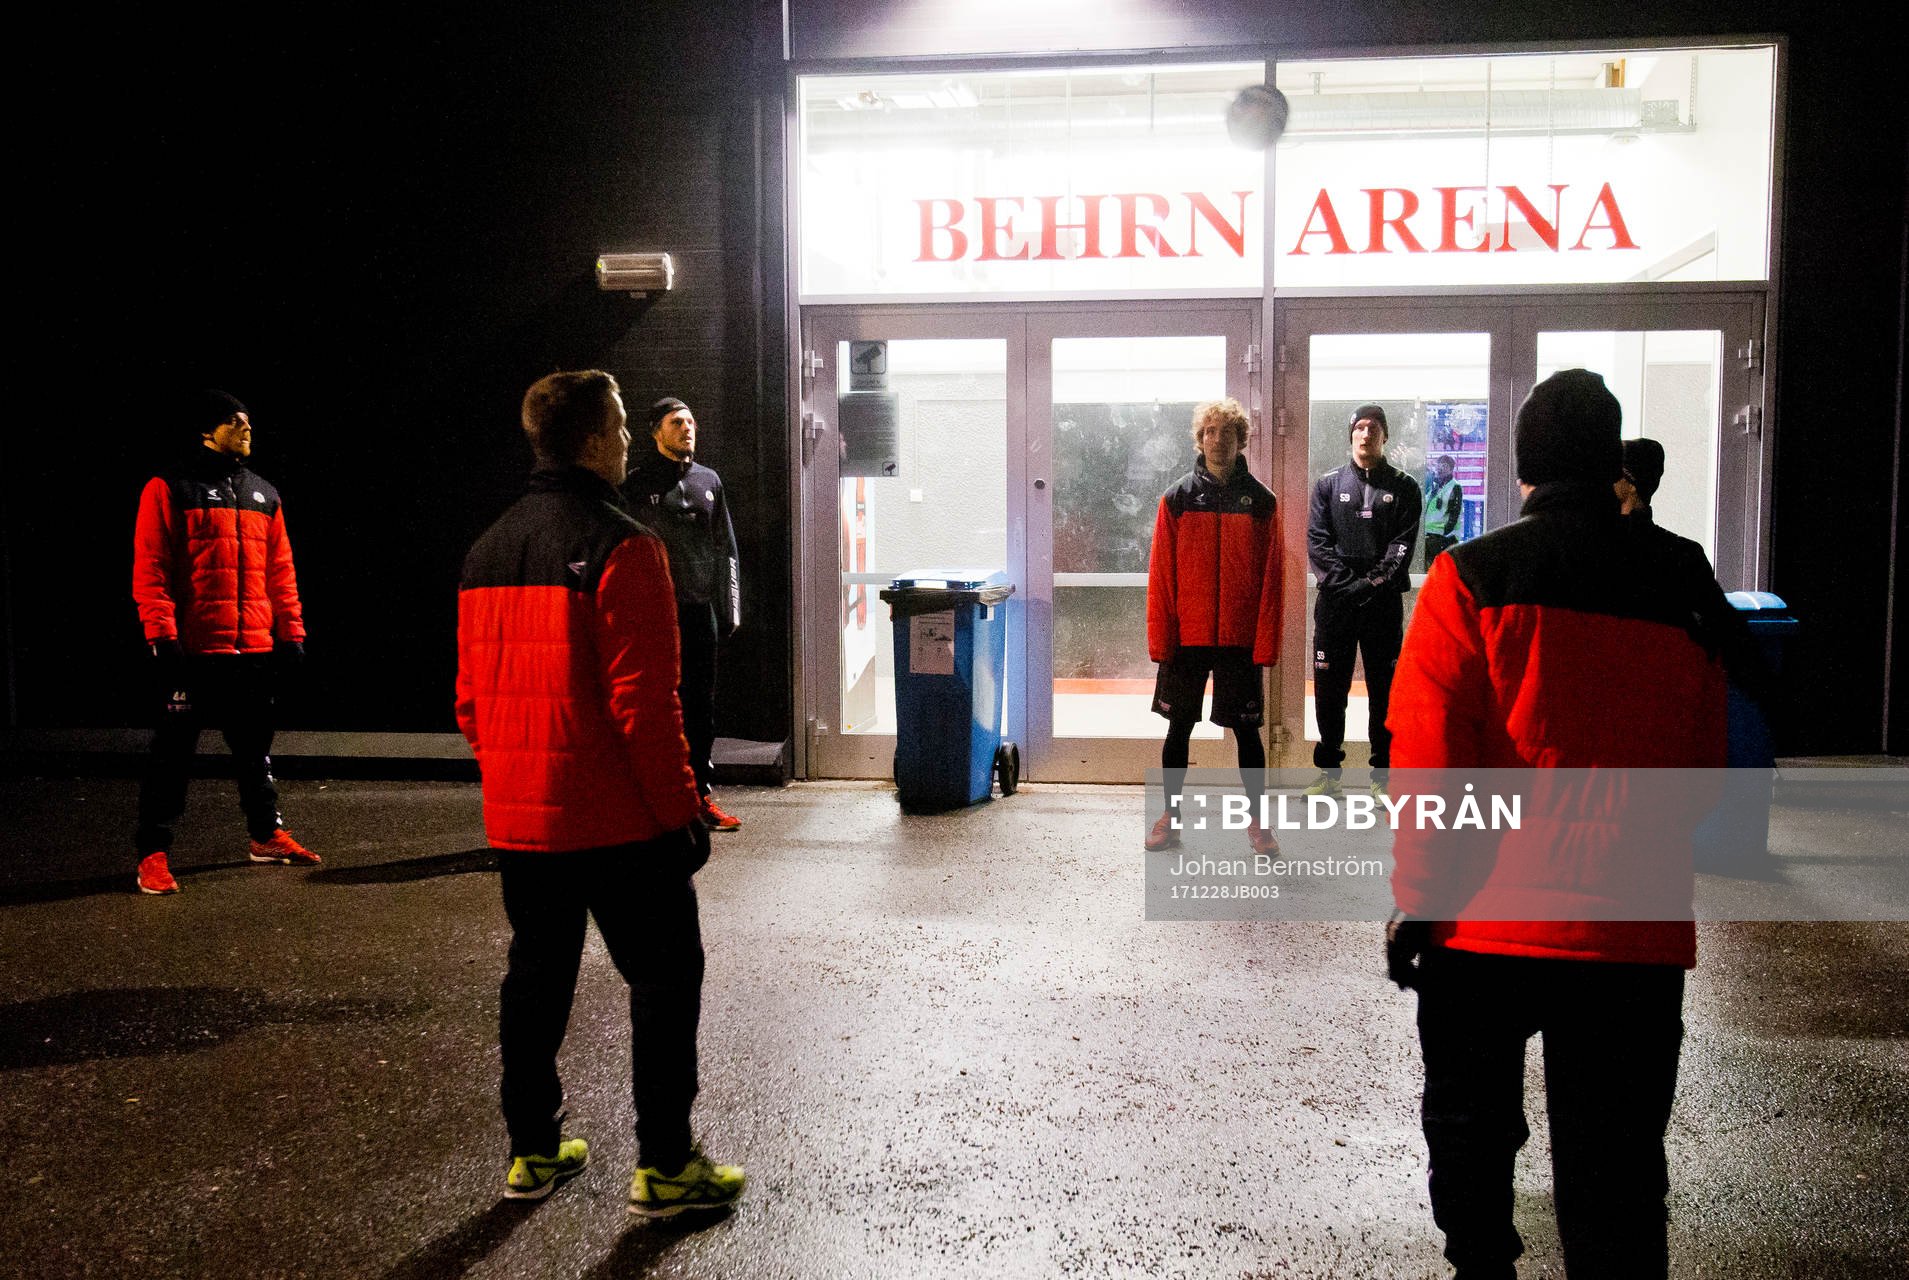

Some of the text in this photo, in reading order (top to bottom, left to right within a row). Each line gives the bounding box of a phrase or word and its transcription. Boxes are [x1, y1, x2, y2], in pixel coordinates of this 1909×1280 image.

[913, 182, 1640, 261] BEHRN ARENA
[650, 494, 660, 504] 17
